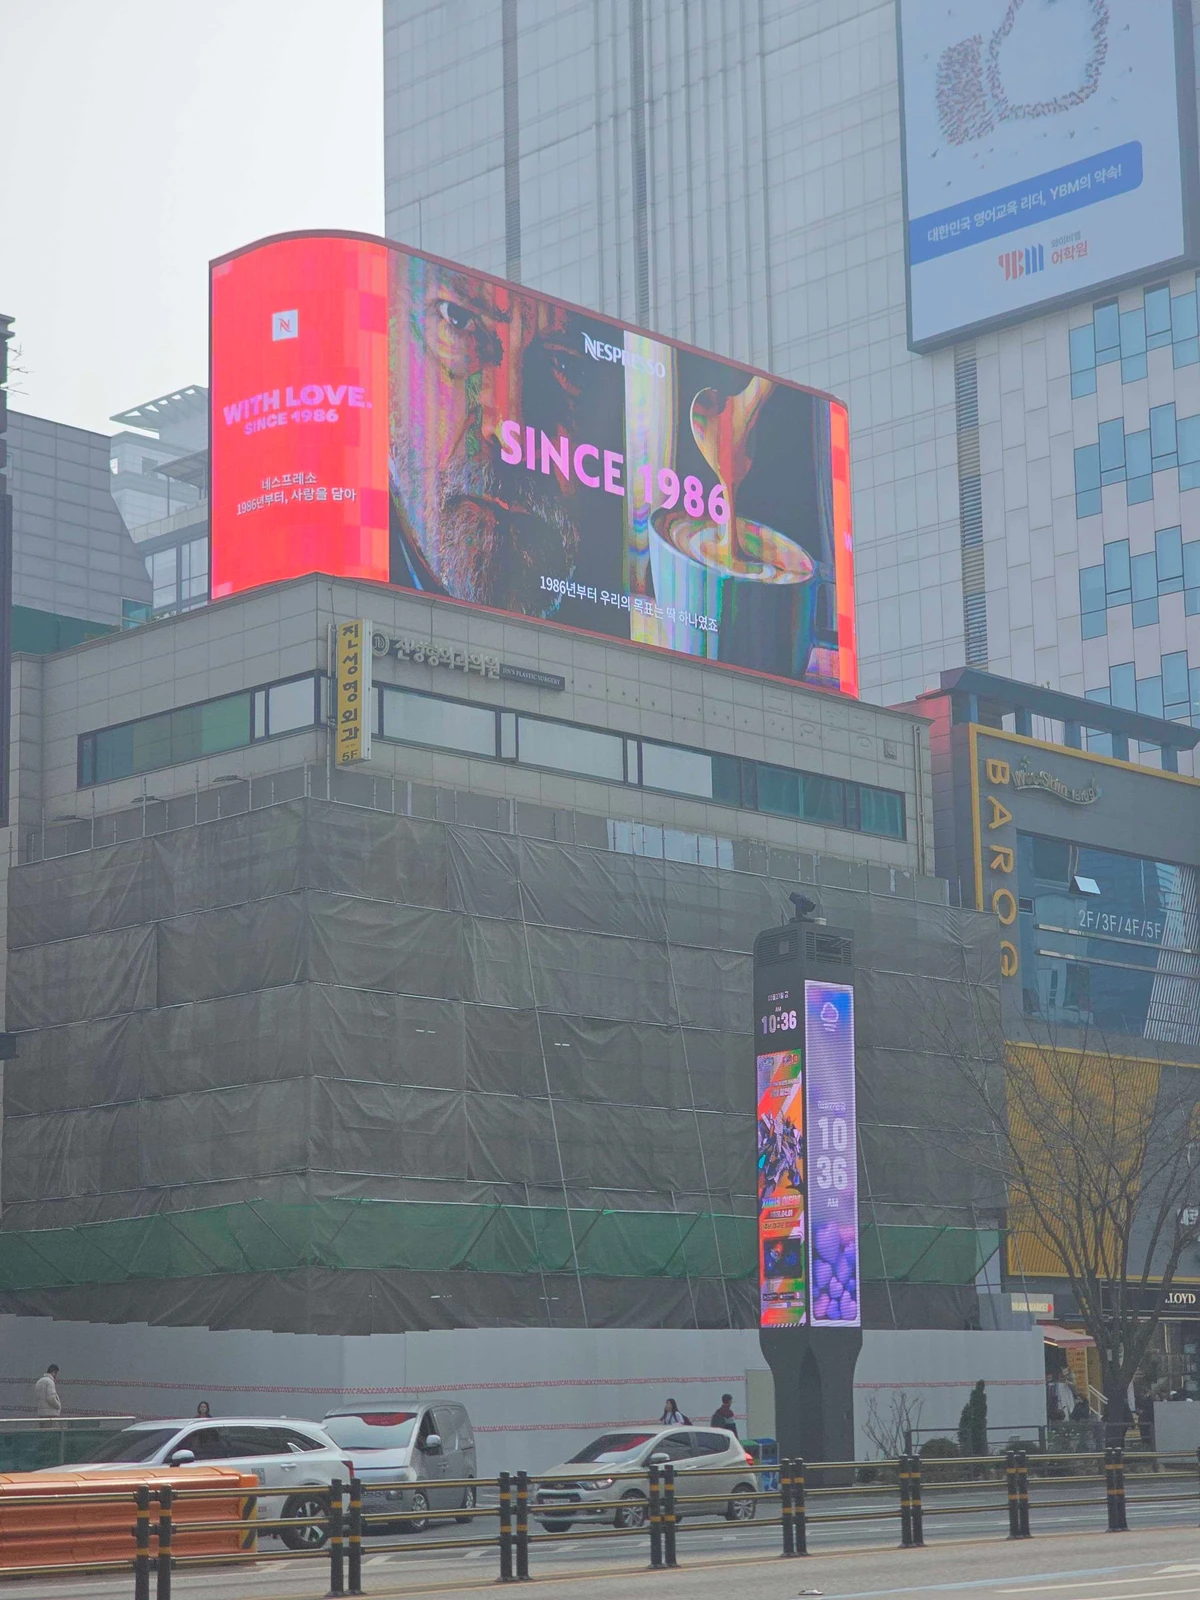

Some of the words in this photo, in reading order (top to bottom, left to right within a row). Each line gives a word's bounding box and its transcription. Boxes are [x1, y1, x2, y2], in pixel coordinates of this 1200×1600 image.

[927, 218, 971, 242] 대한민국
[974, 200, 1018, 228] 영어교육
[1020, 190, 1047, 210] 리더,
[1050, 174, 1092, 200] YBM의
[1094, 163, 1122, 185] 약속!
[1051, 240, 1088, 264] 어학원
[223, 389, 280, 425] WITH
[285, 384, 373, 409] LOVE.
[244, 410, 288, 435] SINCE
[291, 408, 339, 423] 1986
[261, 472, 317, 491] 네스프레소
[500, 420, 625, 496] SINCE
[637, 464, 730, 525] 1986
[236, 491, 288, 516] 1986년부터,
[291, 486, 328, 502] 사랑을
[331, 487, 356, 502] 담아
[540, 575, 597, 604] 1986년부터
[600, 589, 631, 612] 우리의
[633, 598, 664, 620] 목표는
[666, 606, 677, 623] 딱
[678, 608, 718, 633] 하나였죠
[340, 623, 360, 742] 진성형외과
[516, 670, 537, 680] PLASTIC
[538, 675, 561, 685] SURGERY
[342, 749, 358, 762] 5F
[1078, 909, 1162, 940] 2F/3F/4F/5F
[761, 1010, 797, 1034] 10:36
[818, 1117, 847, 1151] 10
[817, 1156, 847, 1190] 36
